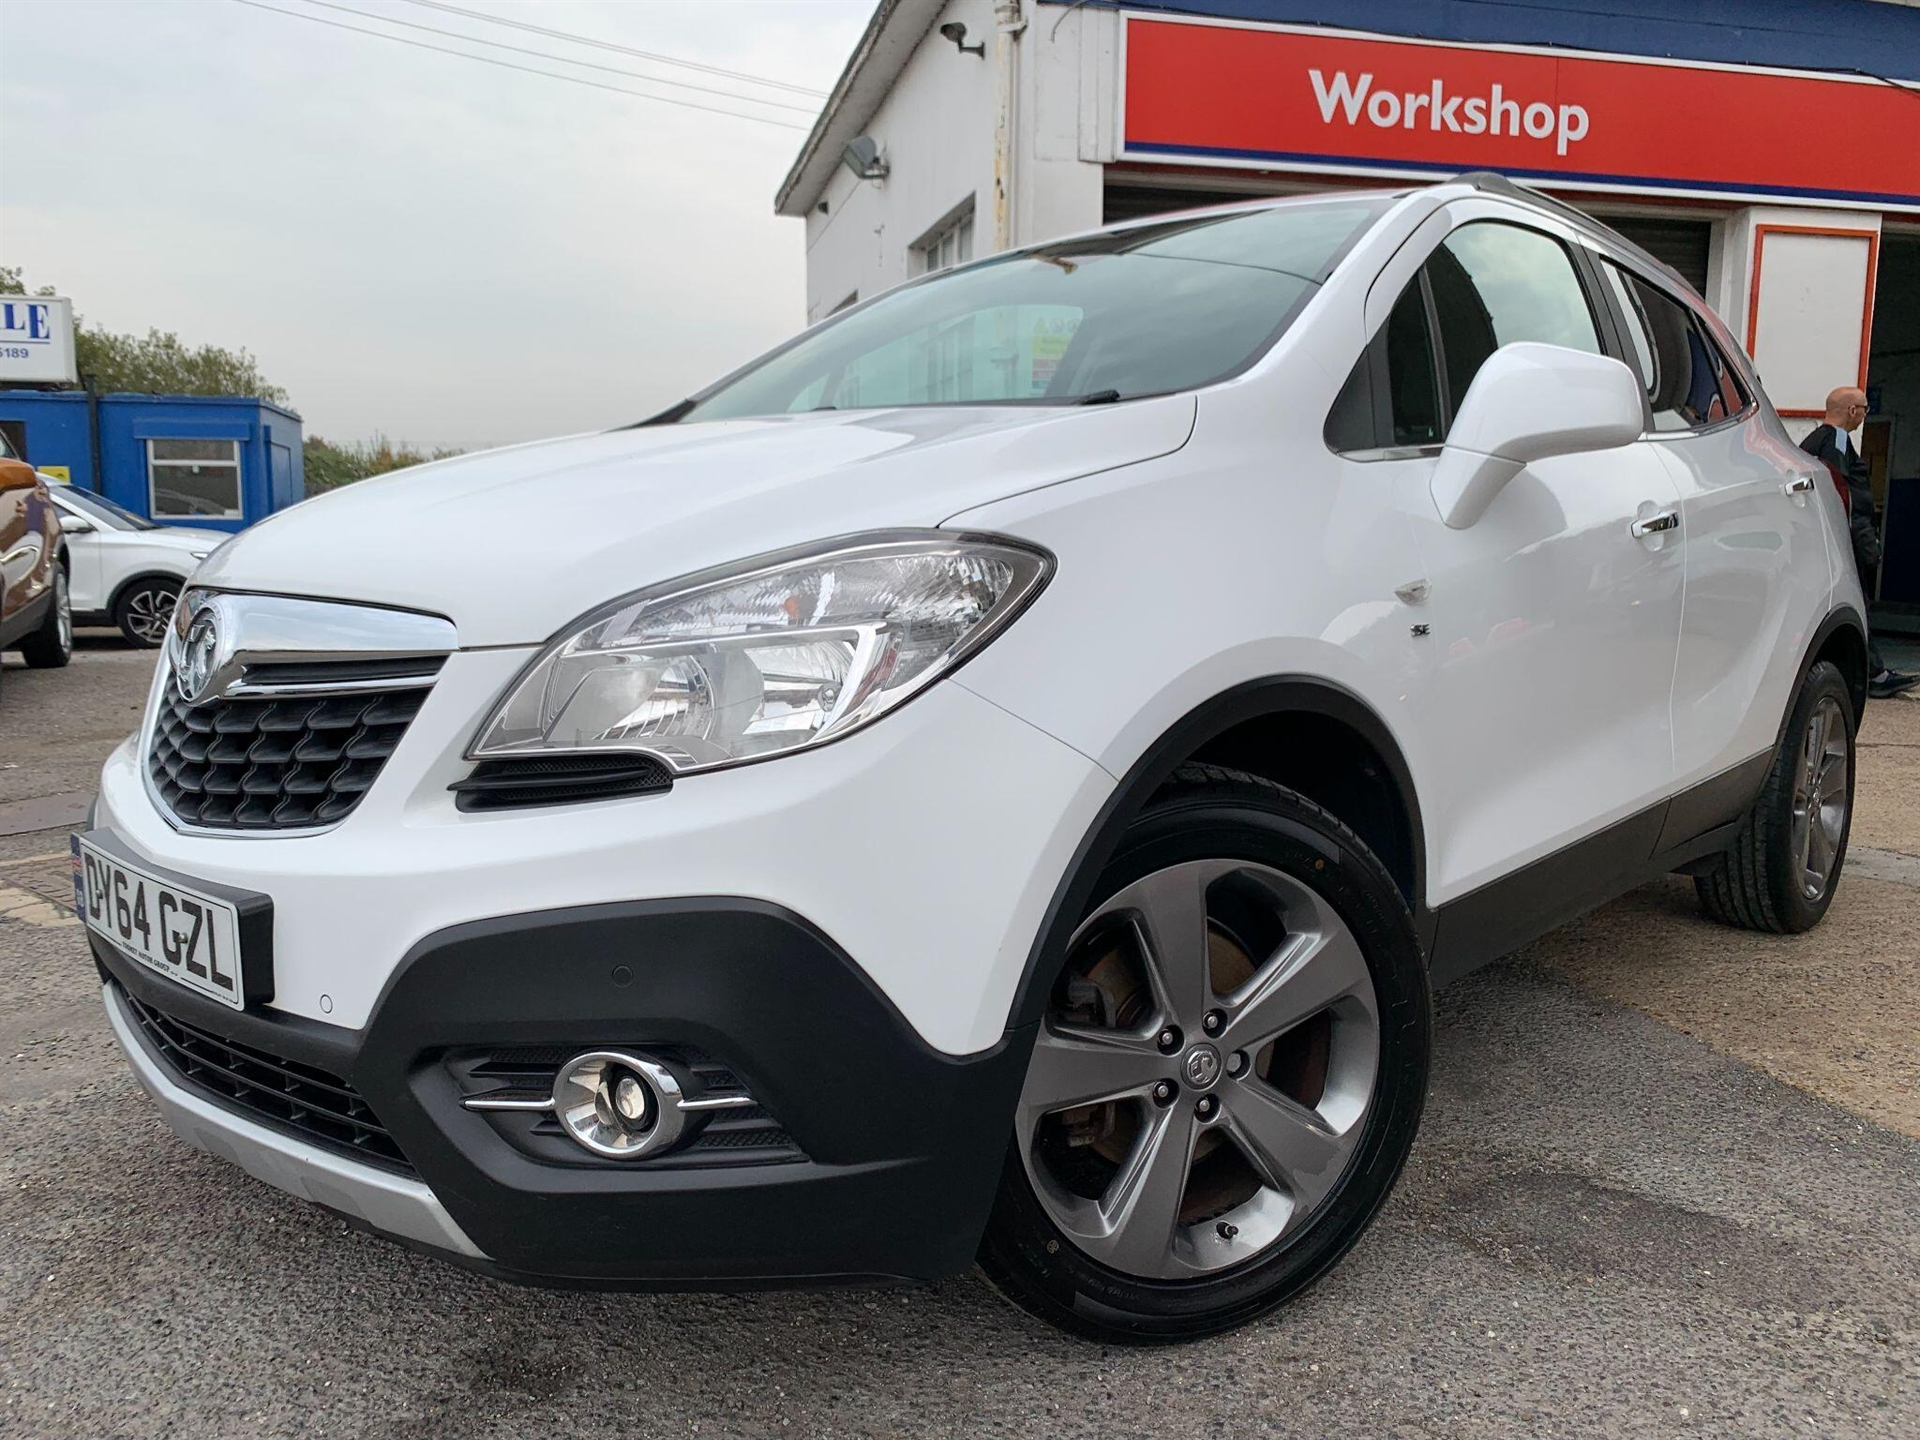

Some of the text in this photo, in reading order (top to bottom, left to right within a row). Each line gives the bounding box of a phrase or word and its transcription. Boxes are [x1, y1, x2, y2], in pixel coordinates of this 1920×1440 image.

[1308, 68, 1590, 156] Workshop
[84, 851, 234, 992] DY64 GZL
